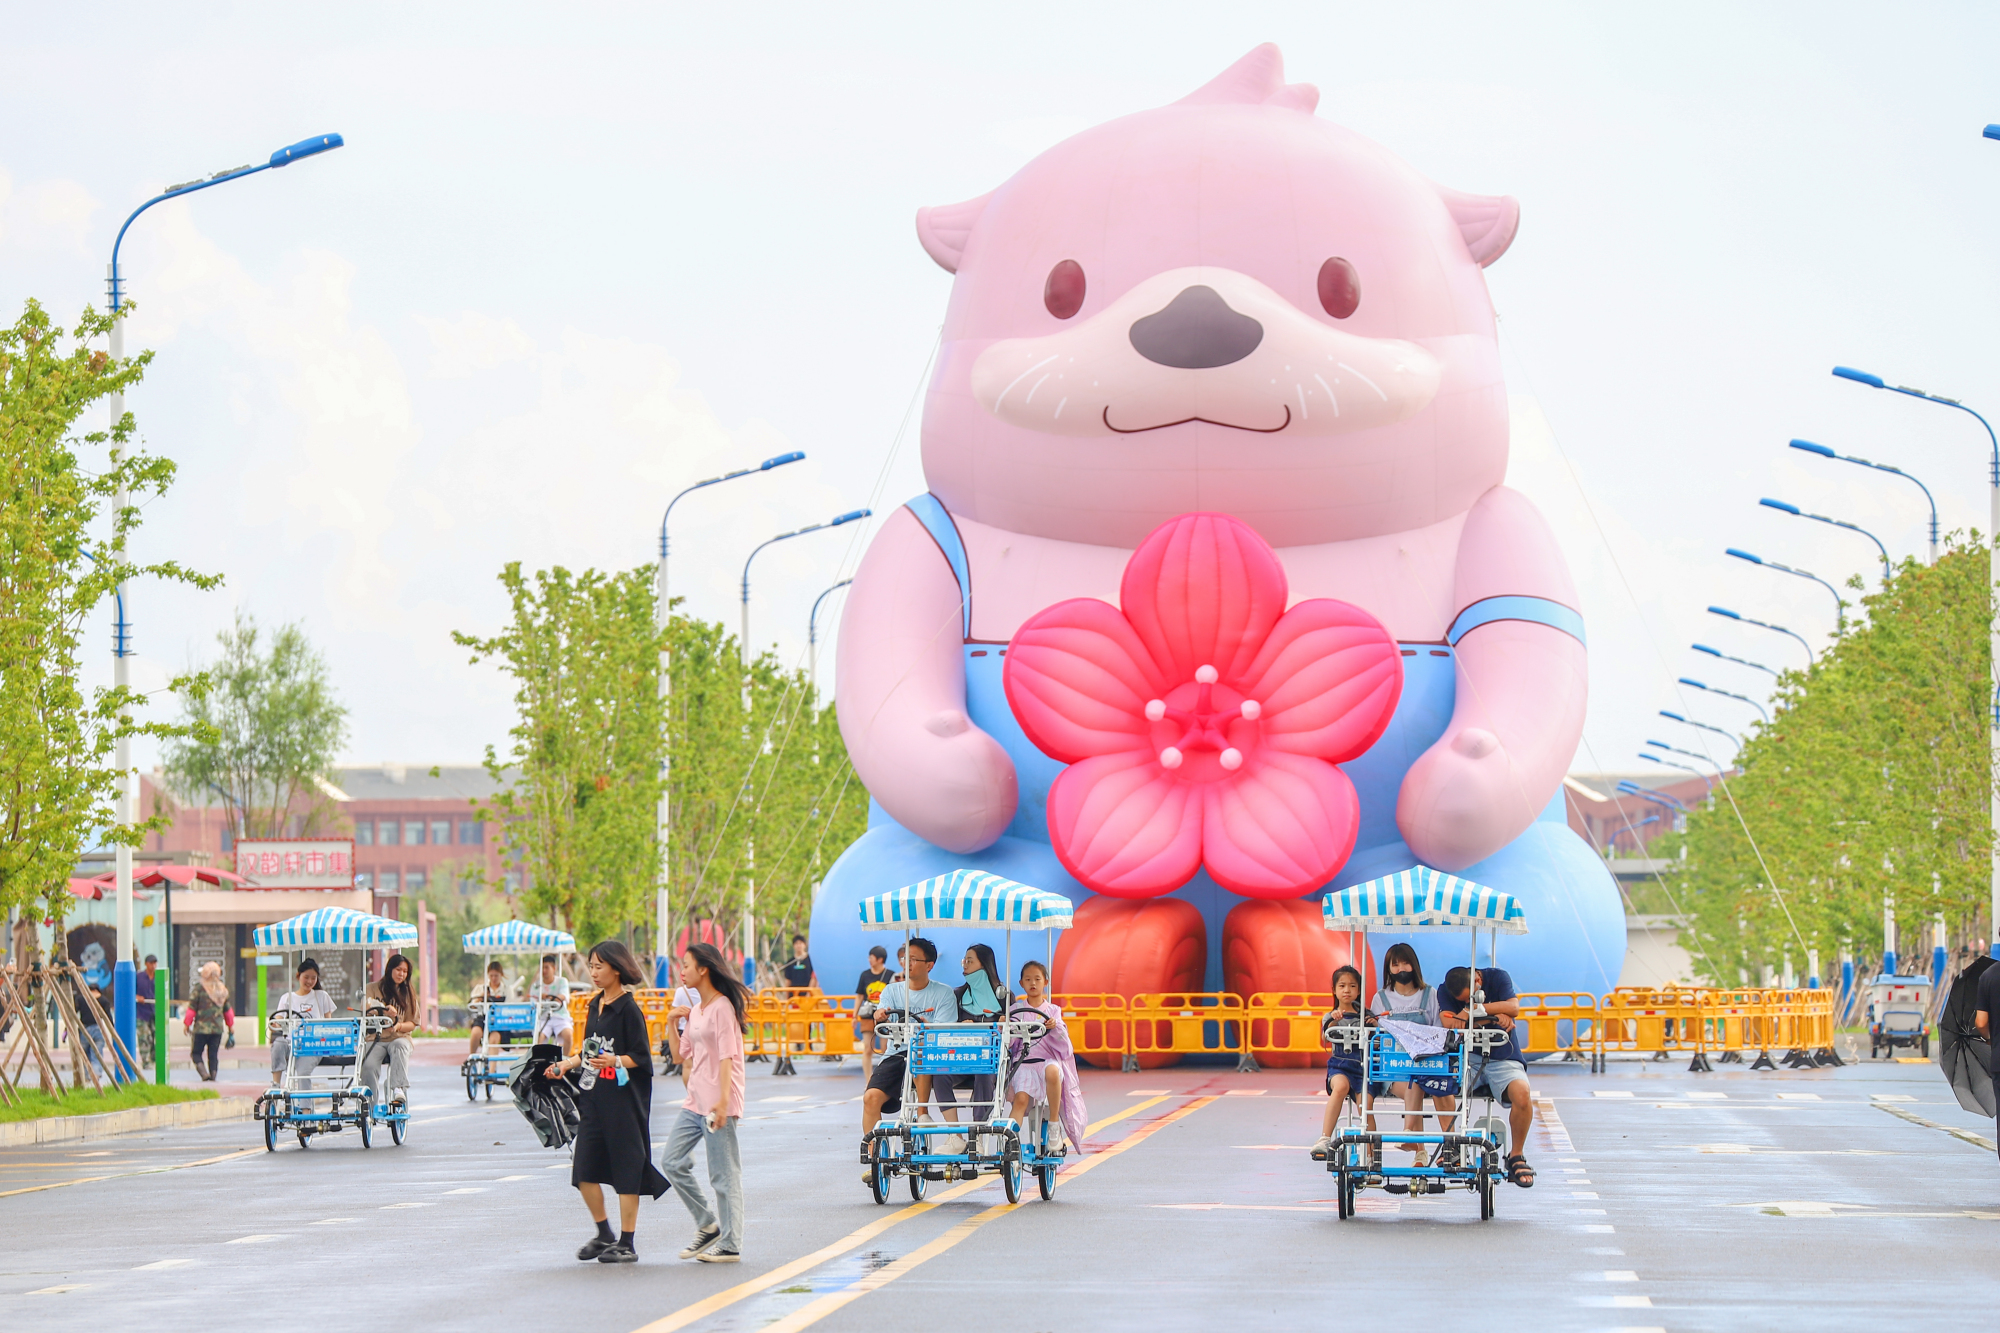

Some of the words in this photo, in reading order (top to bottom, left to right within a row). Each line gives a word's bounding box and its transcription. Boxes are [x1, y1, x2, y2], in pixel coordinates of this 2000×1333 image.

[239, 850, 350, 876] 汉韵轩市集
[926, 1053, 977, 1062] 梅小野星光花海
[1389, 1059, 1444, 1069] 梅小野星光花海
